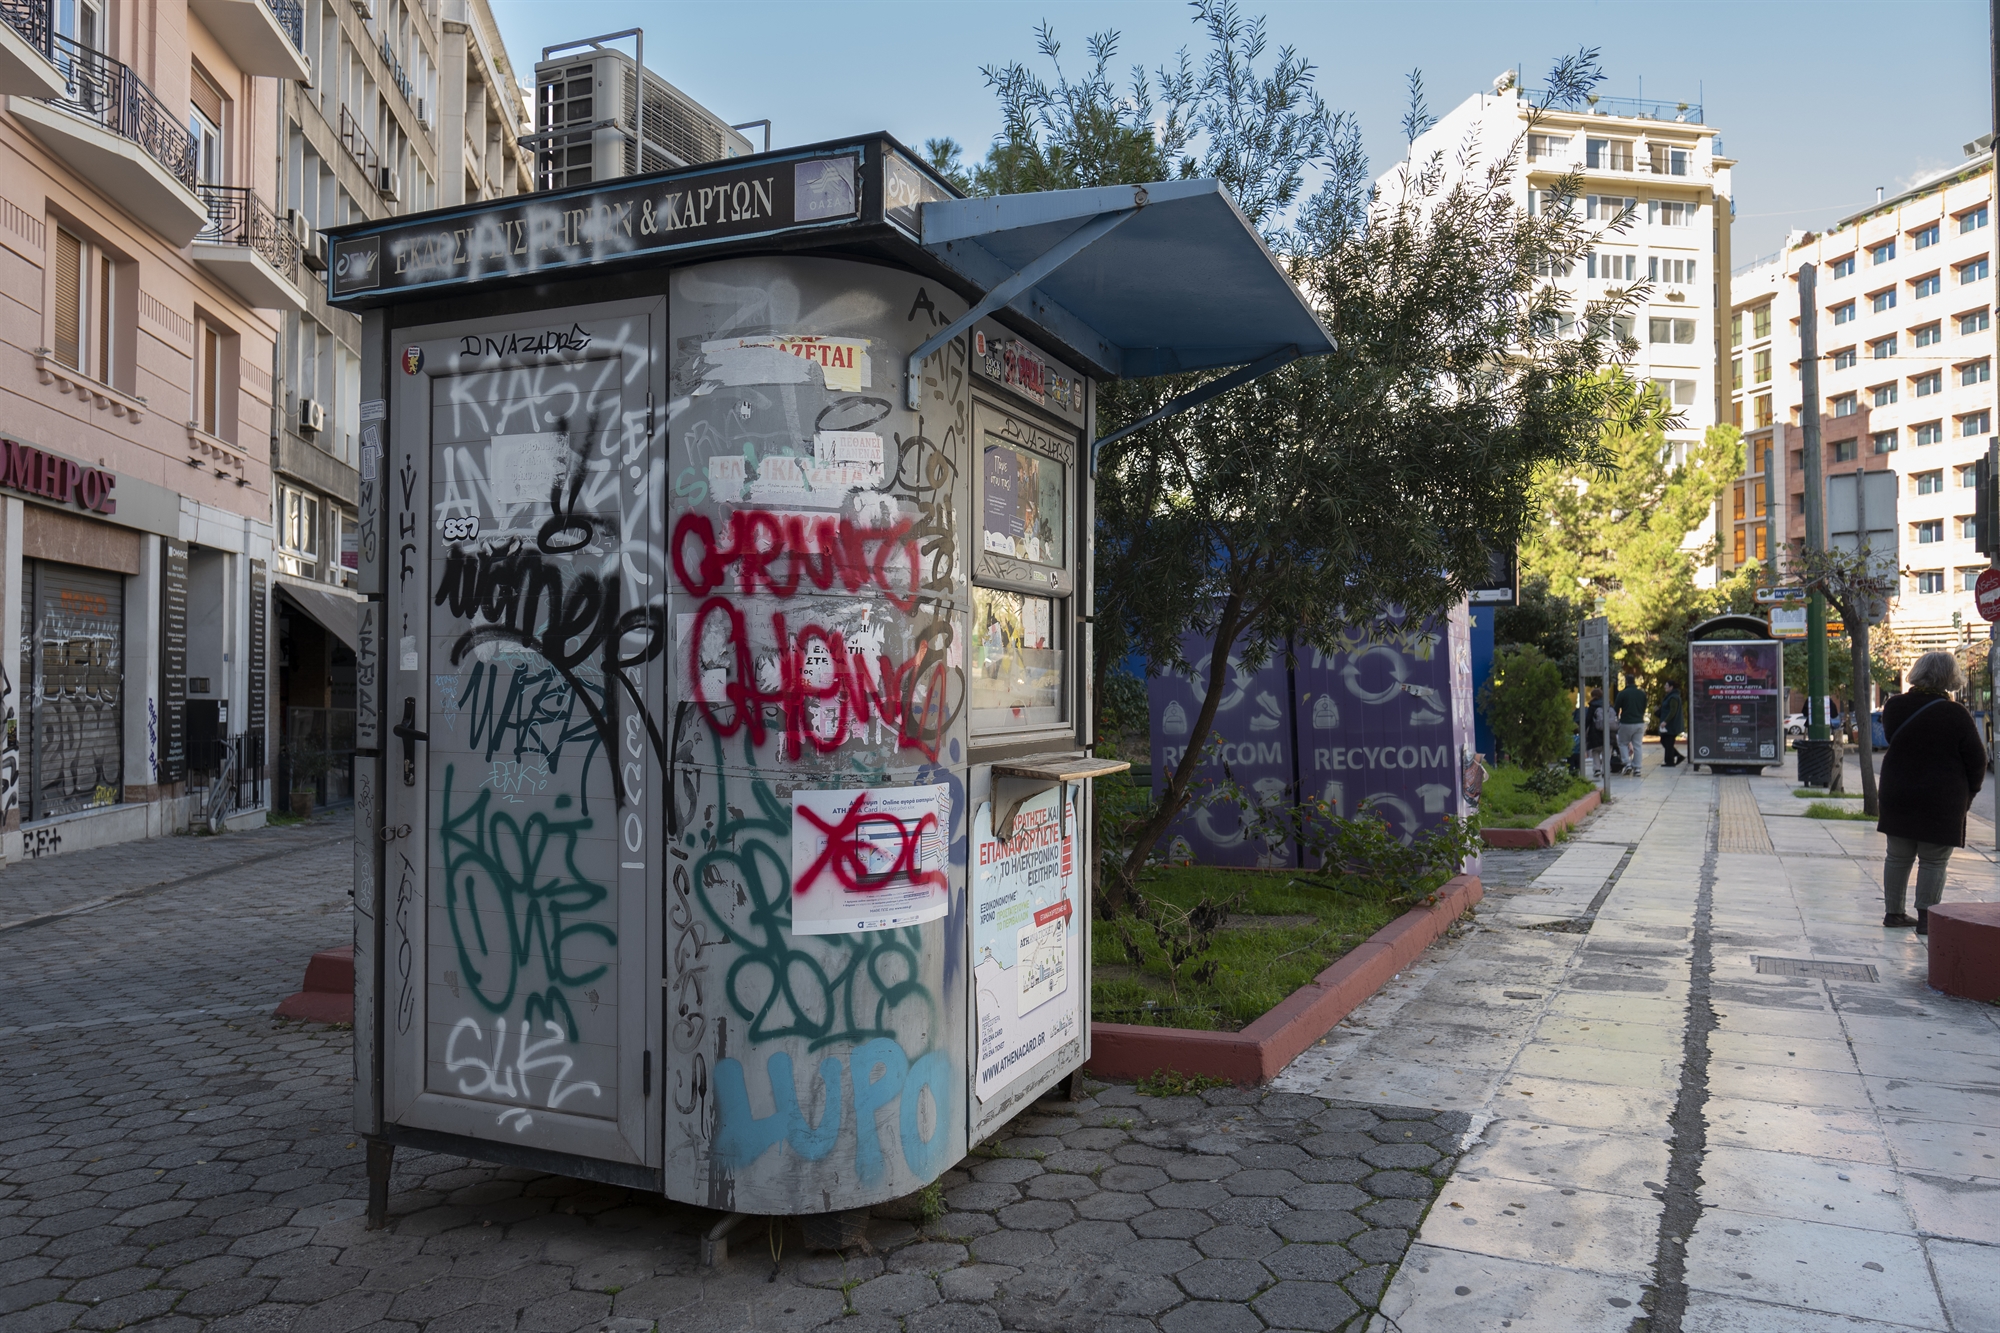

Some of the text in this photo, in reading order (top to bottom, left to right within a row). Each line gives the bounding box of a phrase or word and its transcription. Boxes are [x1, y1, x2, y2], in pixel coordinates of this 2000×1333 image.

[640, 198, 658, 236] &
[665, 177, 774, 232] ΚΑΡΤΩΝ
[444, 516, 480, 540] 837
[1314, 745, 1448, 770] RECYCOM
[864, 805, 878, 813] Card
[1013, 805, 1059, 831] ΚΡΑΤΗΣΤΕ ΚΑΙ
[1011, 845, 1059, 874] ΗΛΕΚΤΡΟΝΙΚΟ
[1028, 862, 1059, 887] ΕΙΣΙΤΗΡΙΟ
[982, 1031, 1046, 1084] WWW.ATHENACARD.GR
